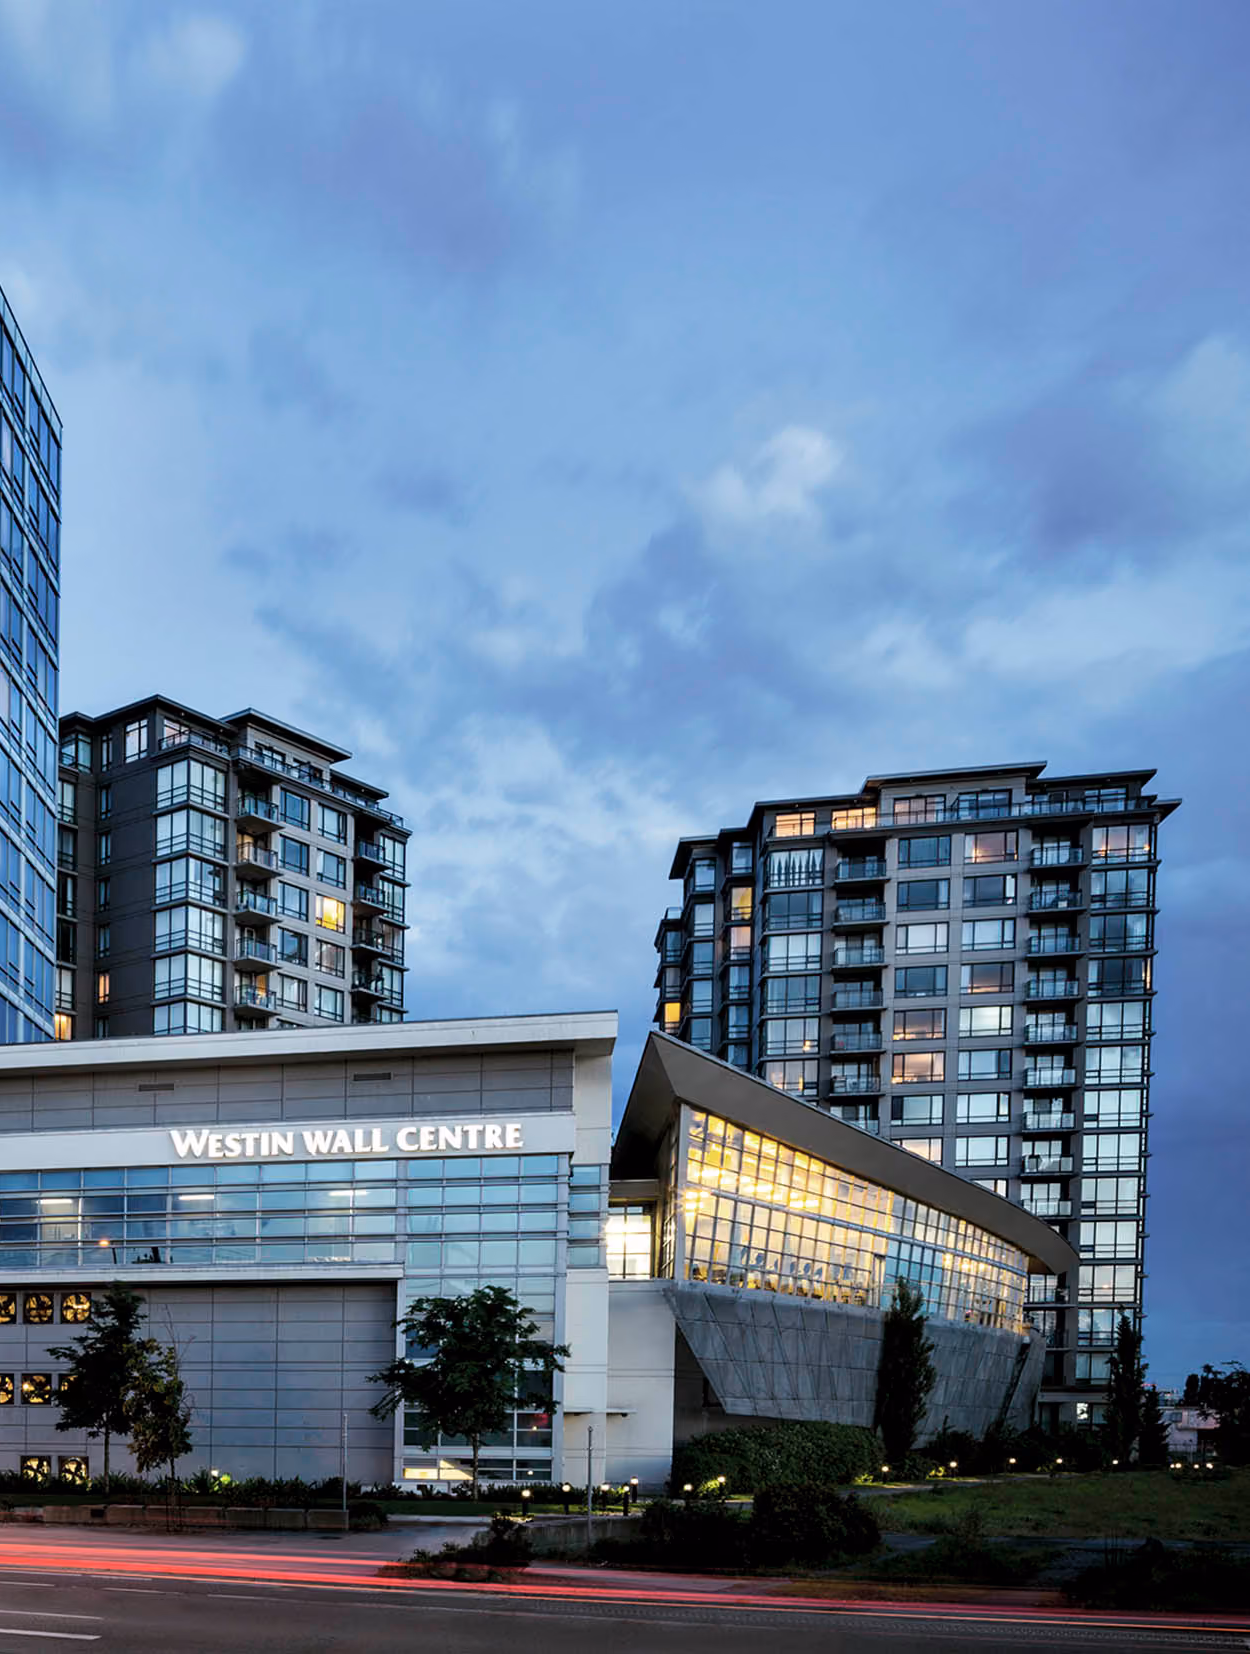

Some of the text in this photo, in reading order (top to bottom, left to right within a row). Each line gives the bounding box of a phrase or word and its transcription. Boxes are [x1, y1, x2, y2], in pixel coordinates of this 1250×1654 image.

[170, 1123, 524, 1158] WESTIN WALL CENTRE
